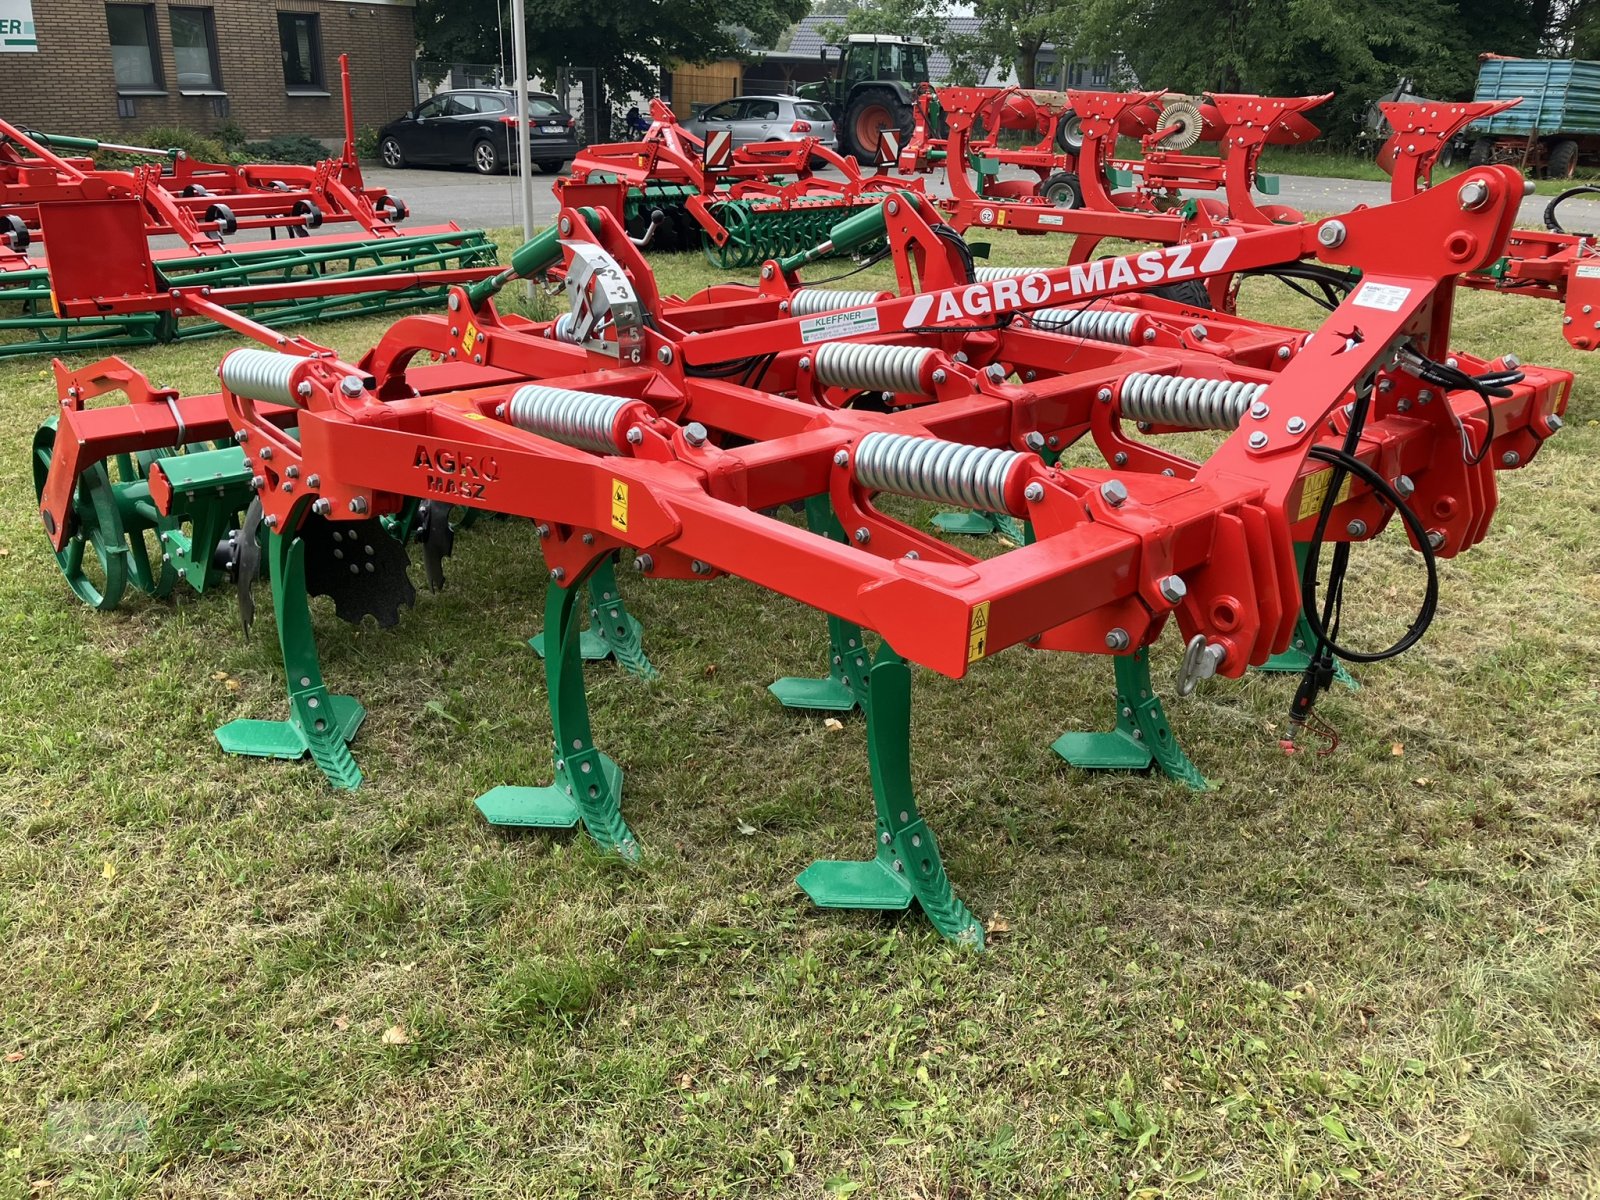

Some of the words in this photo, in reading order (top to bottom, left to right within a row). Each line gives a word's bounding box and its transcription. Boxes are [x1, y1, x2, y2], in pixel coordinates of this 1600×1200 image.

[0, 19, 21, 34] ER
[936, 245, 1195, 322] AGRO-MASZ
[815, 311, 861, 326] KLEFFNER
[412, 444, 500, 482] AGRO
[426, 475, 487, 501] MASZ
